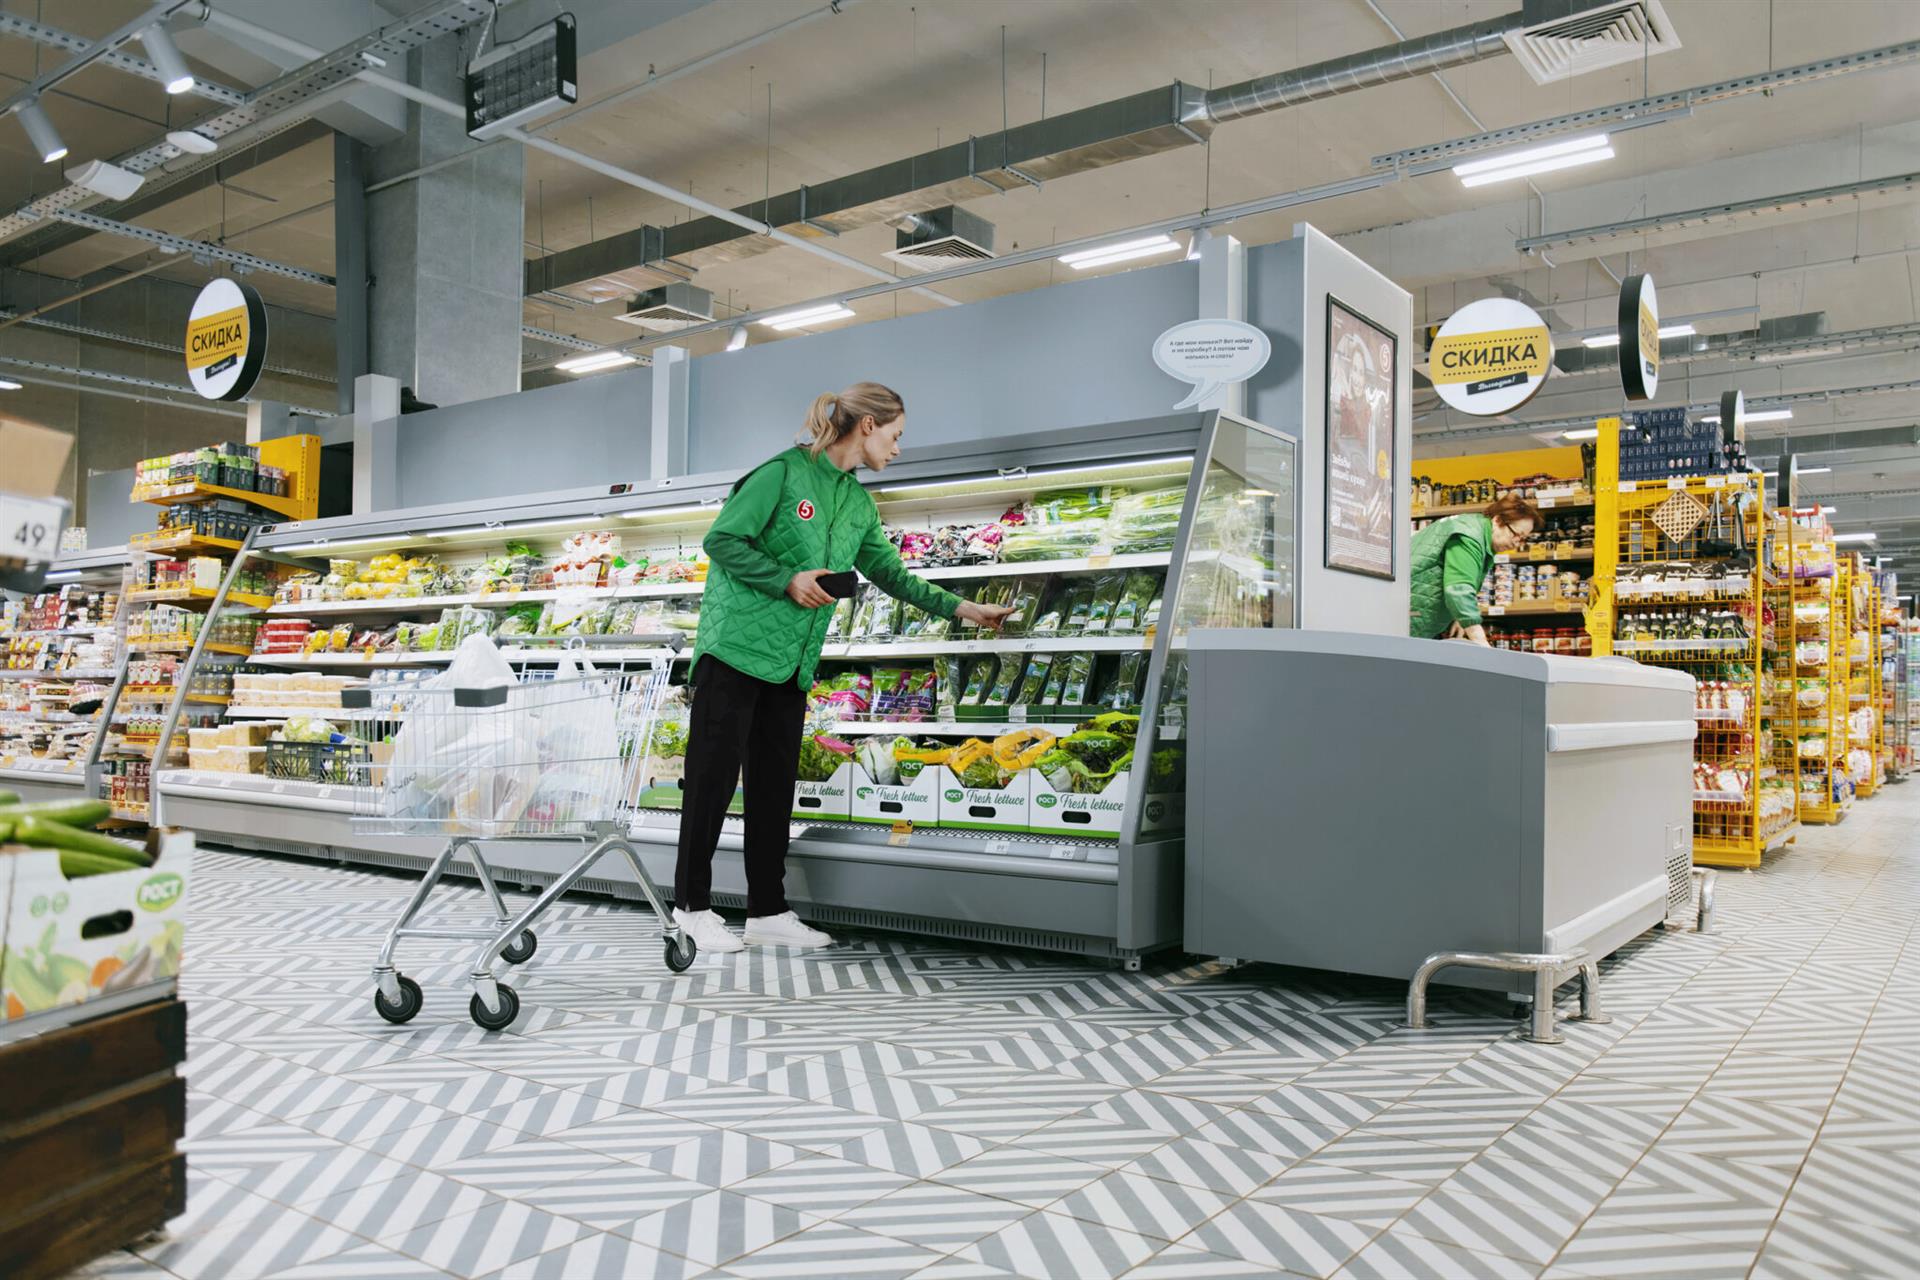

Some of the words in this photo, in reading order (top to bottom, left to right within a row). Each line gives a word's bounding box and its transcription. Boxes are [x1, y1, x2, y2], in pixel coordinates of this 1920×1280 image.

[192, 323, 242, 352] СКИДКА
[1441, 343, 1538, 369] СКИДКА
[14, 521, 46, 547] 49
[818, 785, 845, 797] lettuce
[876, 786, 900, 801] Fresh
[901, 789, 929, 803] lettuce
[945, 791, 963, 799] РОСТ
[966, 789, 993, 805] Fresh
[993, 791, 1025, 806] lettuce
[1038, 796, 1057, 806] РОСТ
[1060, 793, 1088, 810] Fresh
[1089, 796, 1124, 812] lettuce
[142, 880, 180, 903] РОСТ
